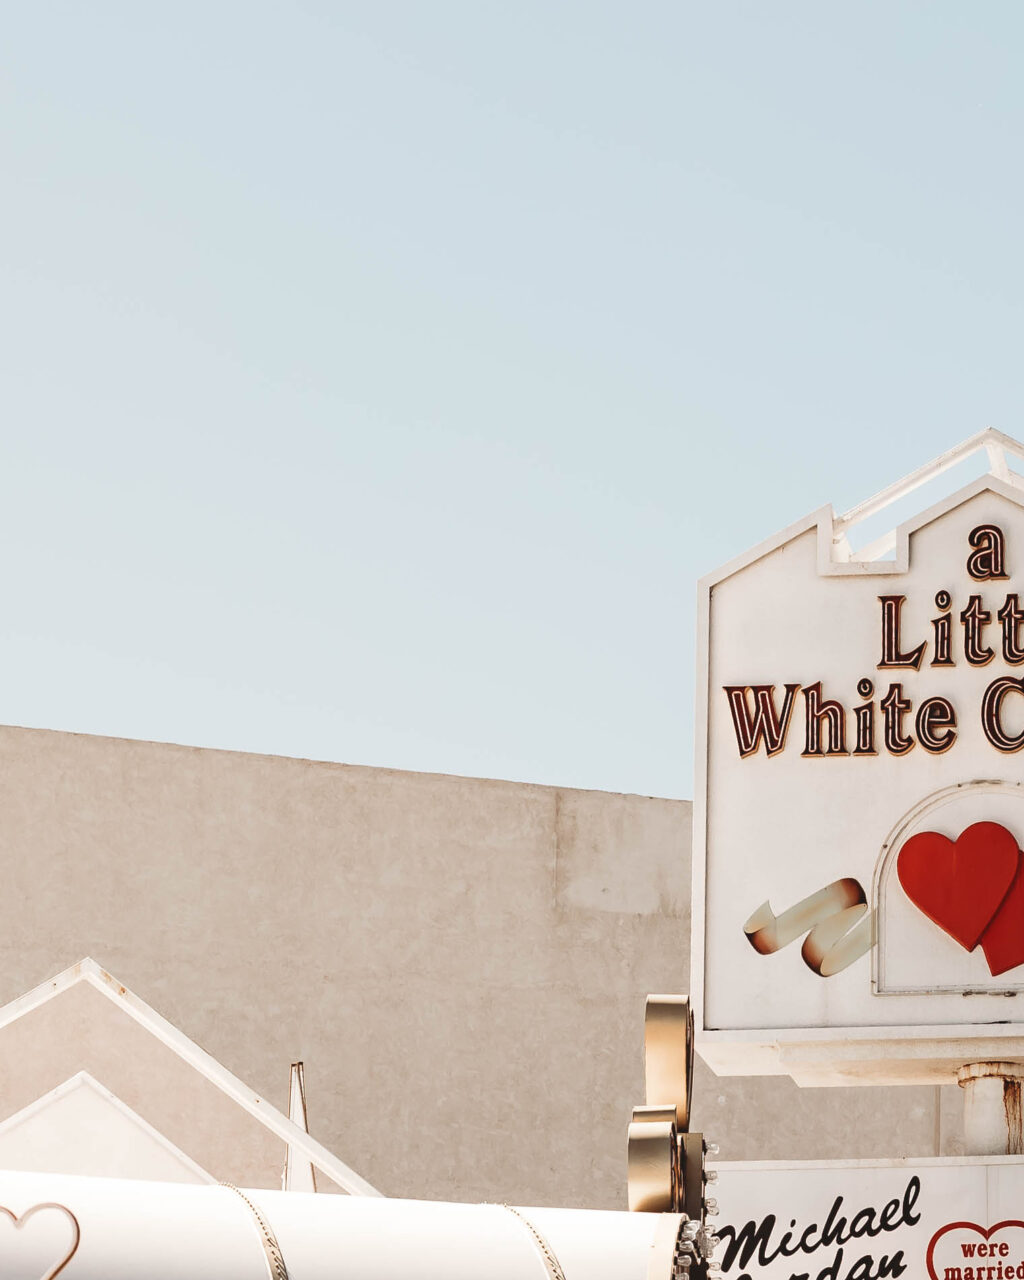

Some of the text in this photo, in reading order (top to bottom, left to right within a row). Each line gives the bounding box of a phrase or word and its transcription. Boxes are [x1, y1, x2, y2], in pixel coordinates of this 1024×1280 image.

[966, 524, 1009, 581] a
[722, 678, 957, 759] White
[712, 1176, 921, 1273] Michael
[960, 1240, 1009, 1258] were
